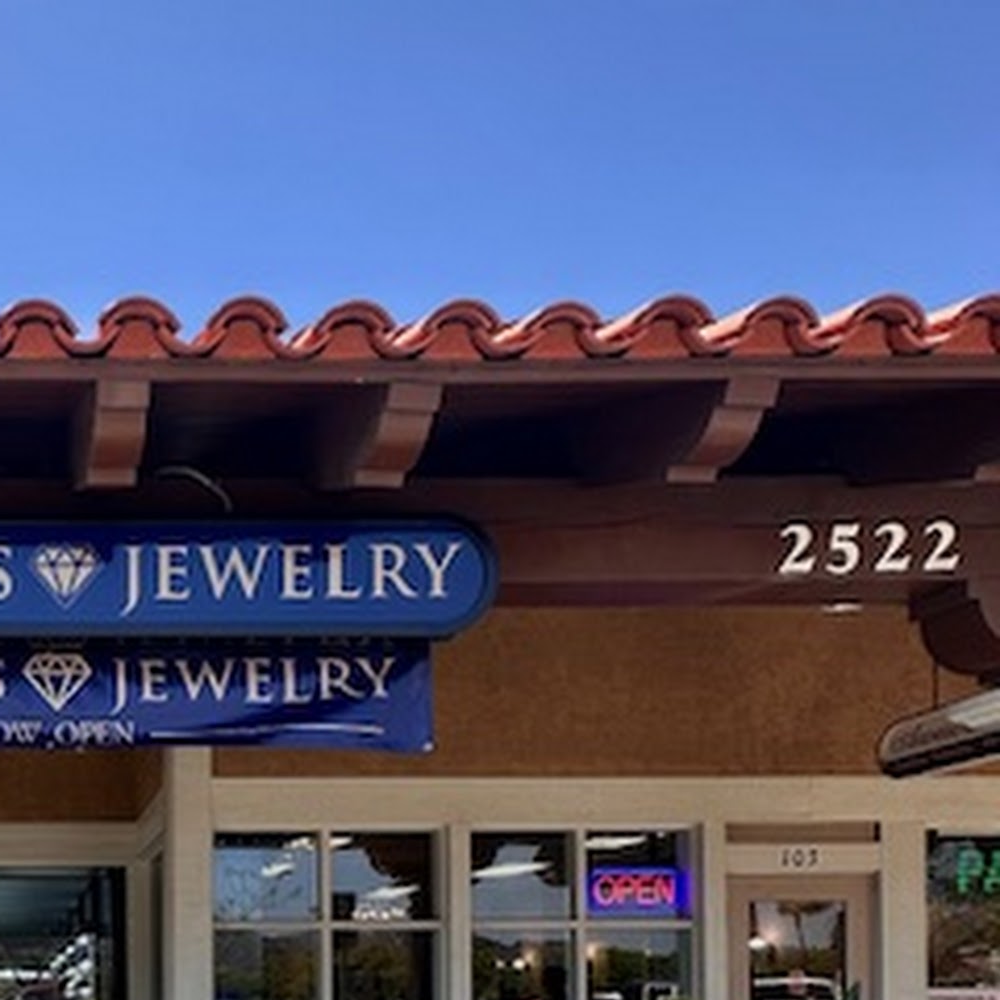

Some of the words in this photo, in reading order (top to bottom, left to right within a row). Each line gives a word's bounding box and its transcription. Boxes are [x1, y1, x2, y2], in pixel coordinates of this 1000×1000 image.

[779, 519, 960, 575] 2522
[121, 542, 462, 616] JEWELRY
[110, 657, 396, 715] JEWELRY
[53, 719, 136, 745] OPEN
[592, 872, 677, 906] OPEN
